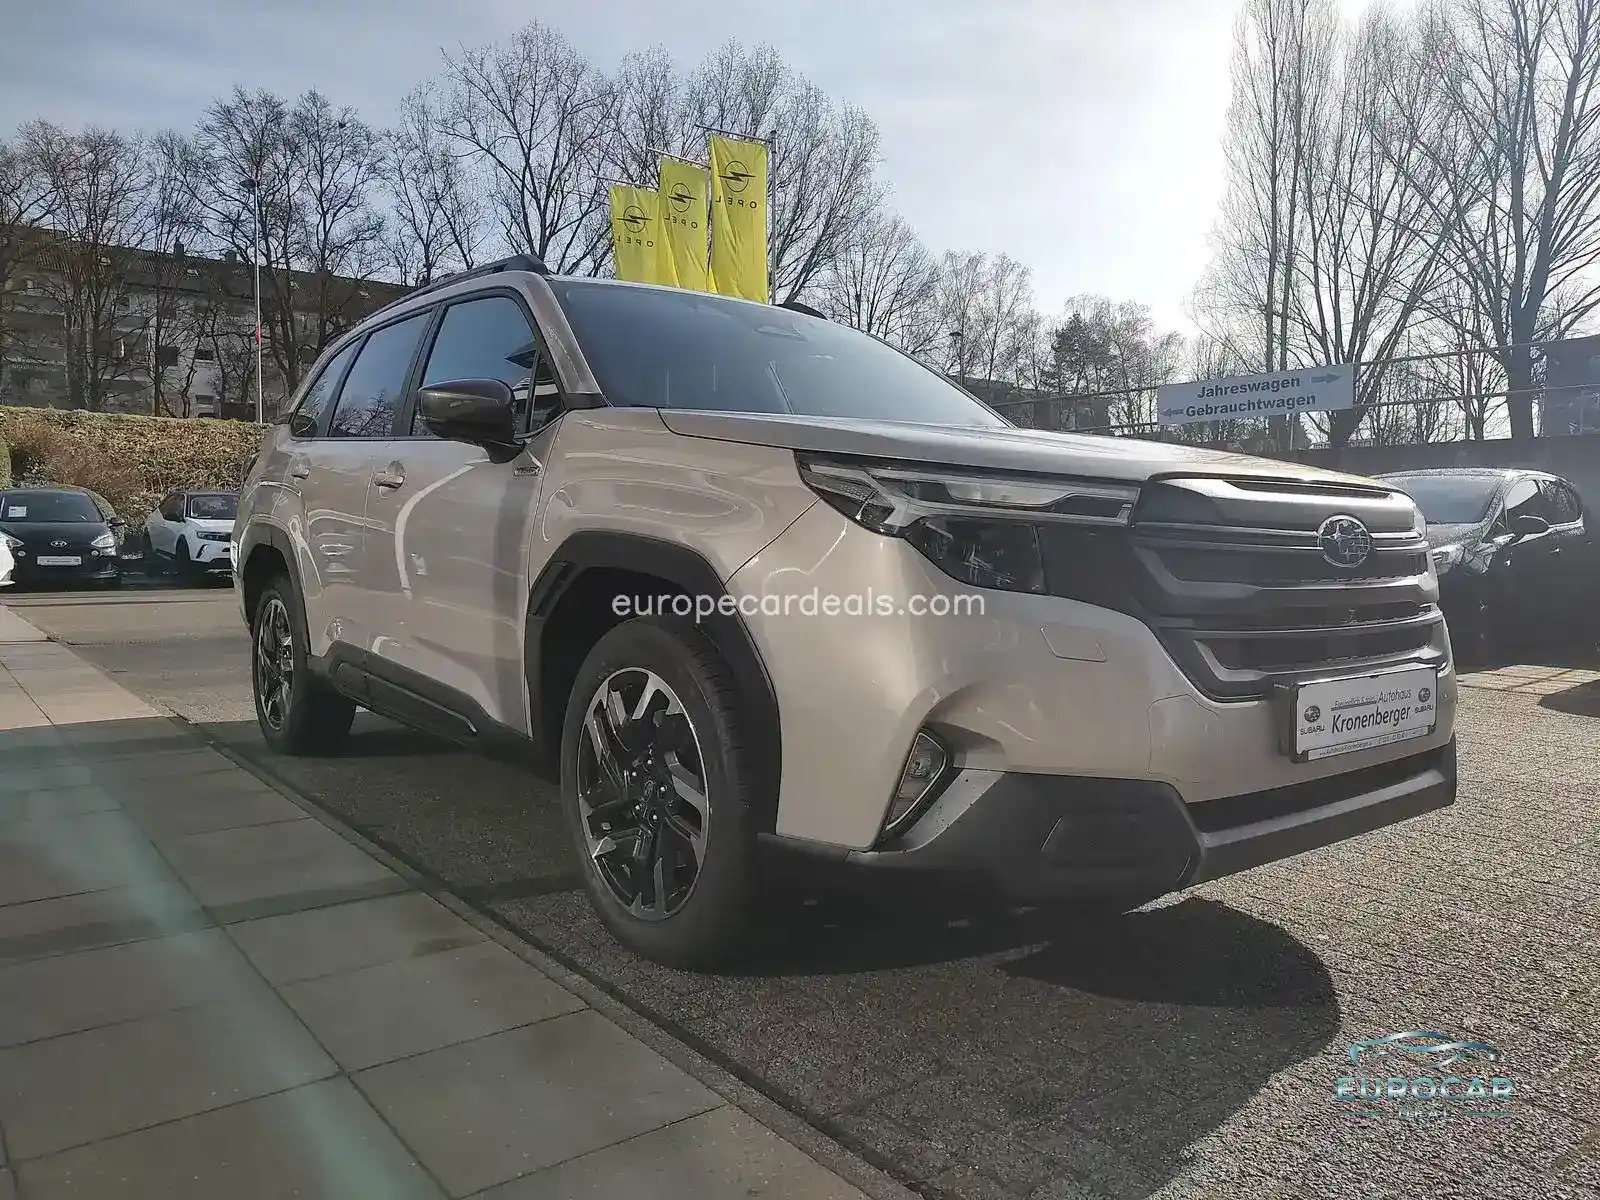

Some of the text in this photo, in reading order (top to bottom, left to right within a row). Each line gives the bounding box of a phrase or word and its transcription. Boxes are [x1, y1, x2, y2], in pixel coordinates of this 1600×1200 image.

[1197, 377, 1300, 399] Jahreswagen
[1186, 394, 1316, 417] Gebrauchtwagen
[1377, 688, 1412, 704] Autohaus
[1300, 725, 1325, 735] SUBARU
[1331, 706, 1411, 734] Kronenberger
